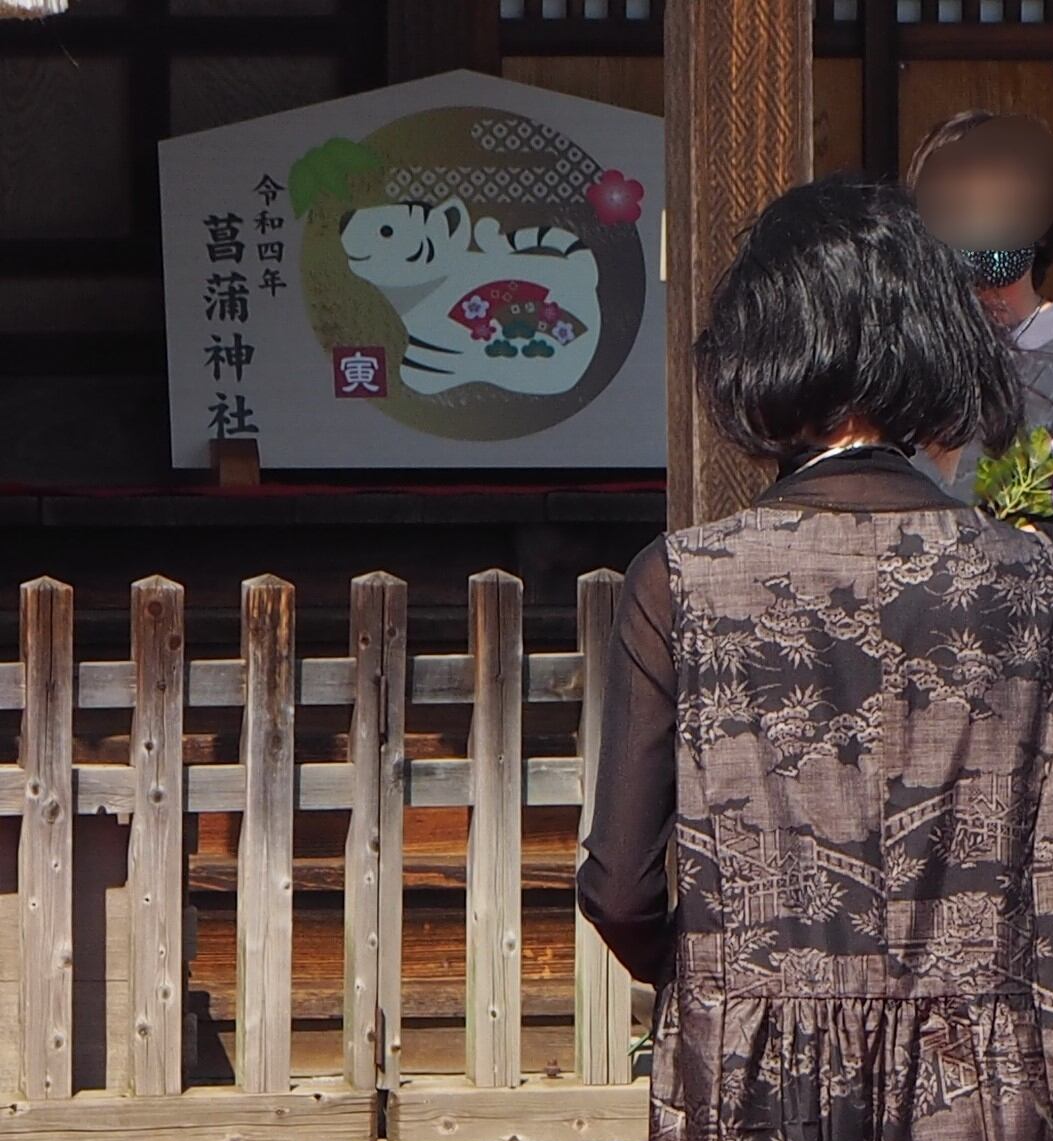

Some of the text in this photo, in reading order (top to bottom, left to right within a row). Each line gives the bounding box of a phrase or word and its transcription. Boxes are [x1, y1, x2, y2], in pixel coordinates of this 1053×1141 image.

[253, 173, 288, 297] 令和四年
[202, 212, 260, 440] 菖蒲神社
[340, 351, 380, 393] 寅
